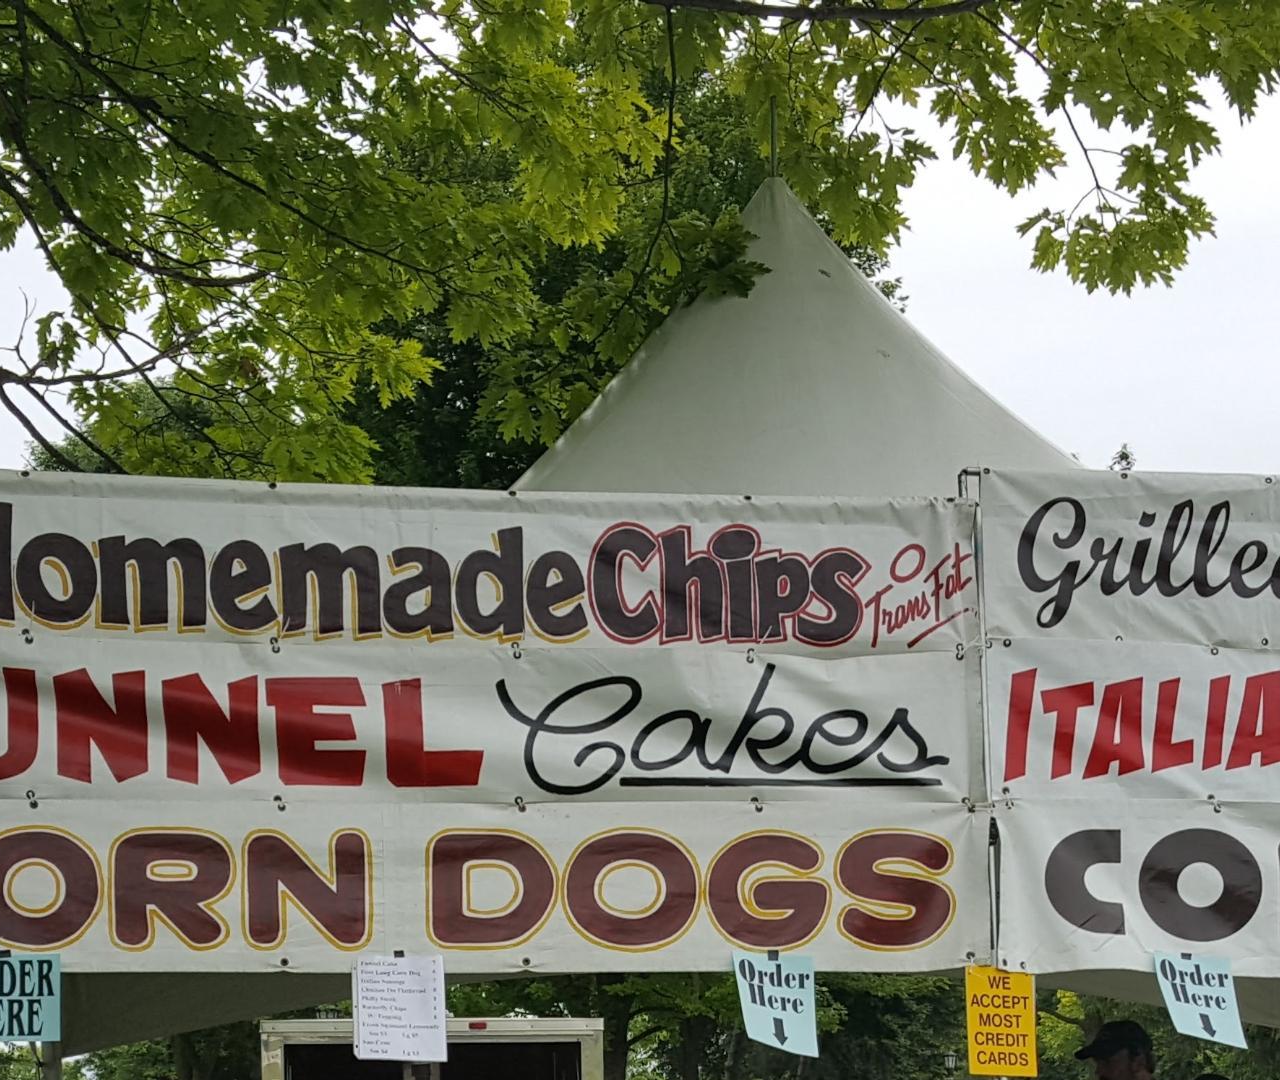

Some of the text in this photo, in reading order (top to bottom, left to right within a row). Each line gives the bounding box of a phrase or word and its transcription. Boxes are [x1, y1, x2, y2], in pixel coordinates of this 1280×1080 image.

[588, 519, 871, 648] Chips
[864, 542, 973, 648] Trans Fat
[496, 662, 949, 797] Cakes
[425, 827, 957, 953] DOGS
[738, 958, 810, 990] Order
[987, 975, 1011, 990] WE
[1160, 958, 1229, 988] Order
[748, 982, 805, 1014] Here
[970, 993, 1030, 1011] ACCEPT
[1171, 982, 1227, 1010] Here
[978, 1013, 1022, 1029] MOST
[974, 1031, 1029, 1048] CREDIT
[976, 1050, 1029, 1066] CARDS
